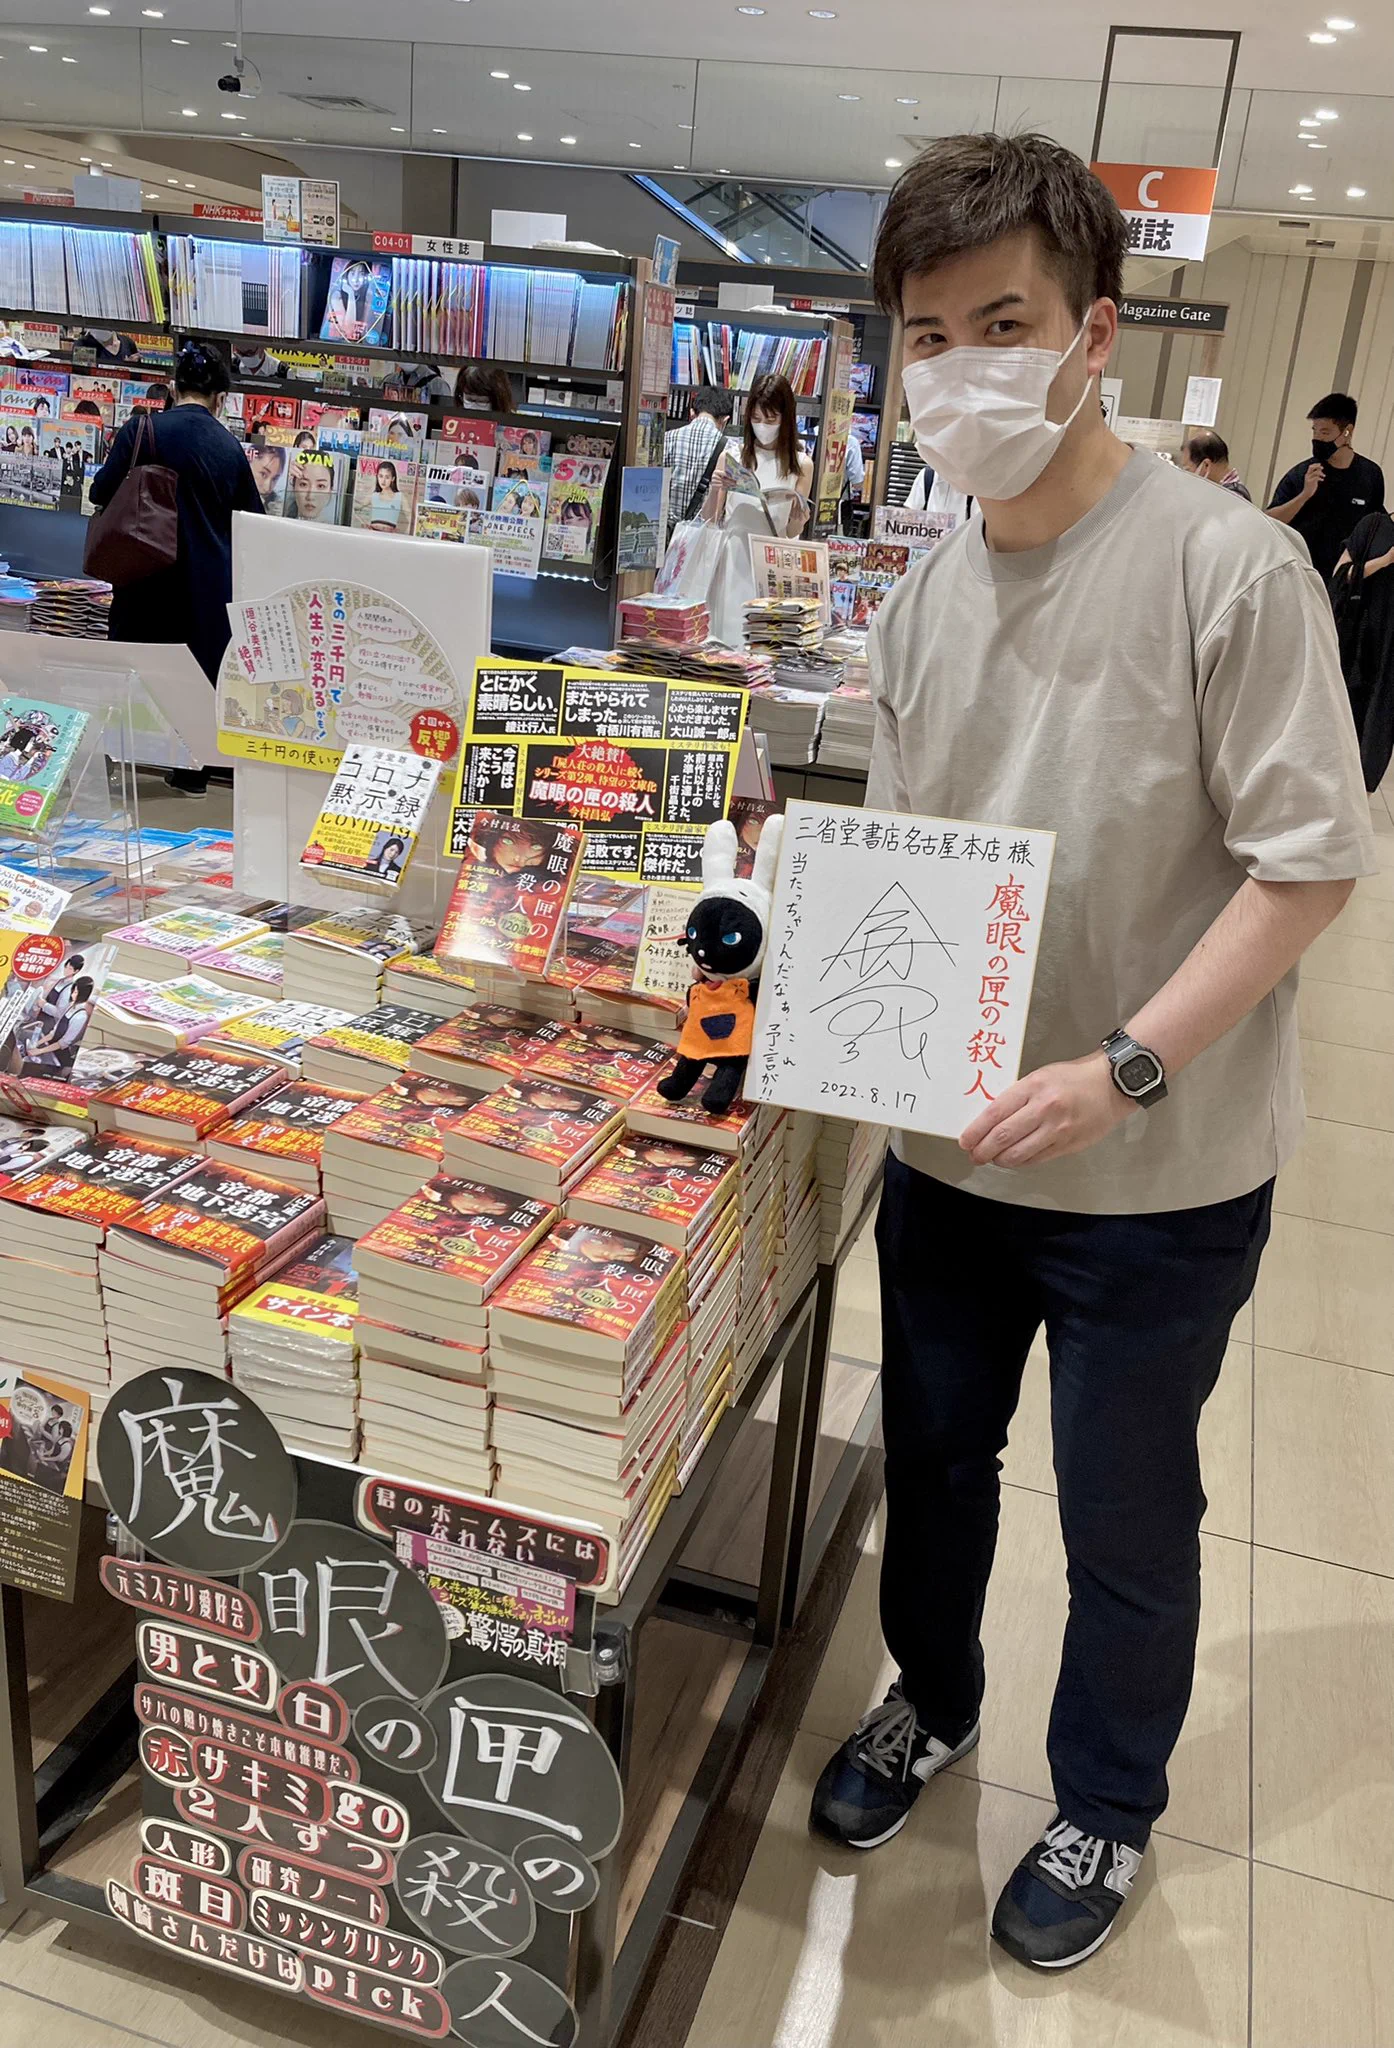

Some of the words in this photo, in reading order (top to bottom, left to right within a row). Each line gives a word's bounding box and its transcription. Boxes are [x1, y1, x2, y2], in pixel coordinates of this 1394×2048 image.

[1138, 171, 1164, 208] C
[374, 235, 410, 249] C04-01
[427, 239, 470, 255] 女性誌
[1180, 307, 1211, 321] Gate
[296, 451, 334, 467] CYAN
[885, 519, 943, 540] Number
[329, 591, 345, 703] その三千円で
[477, 692, 558, 713] 素晴らしい。
[480, 675, 538, 694] とにかく
[565, 690, 650, 708] またやられて
[418, 714, 452, 729] 全国から
[505, 720, 556, 734] 綾辻行人氏
[565, 707, 623, 724] しまった。
[668, 703, 739, 716] 心から楽しませて
[668, 713, 732, 727] いただきました。
[417, 729, 452, 752] 反響
[595, 723, 661, 738] 有栖川有栖氏
[670, 725, 737, 741] 大山誠一郎氏
[340, 760, 430, 790] コロナ
[491, 747, 503, 775] こう
[692, 752, 707, 807] 前作以上の
[529, 779, 655, 815] 魔眼の匣の殺人
[534, 767, 658, 793] シリーズ第2弾、待望の文庫化
[680, 752, 695, 822] 水準に達した。
[713, 753, 725, 809] 高いハードルを
[328, 782, 421, 819] 黙示録
[568, 806, 612, 822] 今村昌弘
[479, 816, 522, 833] 今村昌弘
[795, 815, 1002, 863] 三省堂書店名古屋本店
[1007, 838, 1036, 868] 様
[583, 843, 638, 860] 完敗です。
[643, 858, 691, 875] 傑作だ。
[456, 879, 488, 894] 第2弾
[508, 872, 538, 915] 殺人
[529, 831, 575, 939] 魔眼の匣の
[963, 872, 1030, 1102] 魔眼の匣の殺人
[146, 1062, 251, 1094] 地下迷宮
[186, 1058, 244, 1077] 帝都
[299, 1095, 358, 1119] 帝都
[820, 1081, 917, 1113] 2022.8.17
[58, 1151, 172, 1188] 地下迷宮
[104, 1147, 168, 1169] 帝都
[171, 1182, 287, 1230] 地下迷宮
[215, 1179, 281, 1206] 帝都
[456, 1215, 496, 1242] 殺人
[591, 1263, 628, 1293] 殺人
[117, 1376, 280, 1544] 魔
[376, 1486, 596, 1561] 君のホームズには
[430, 1520, 535, 1562] なれない
[116, 1568, 247, 1630] 元ミステリ愛好会
[257, 1555, 420, 1701] 眼
[149, 1630, 261, 1699] 男と女
[293, 1692, 334, 1736] 白
[141, 1695, 350, 1778] サバの照り焼きこそ本格推理だ。
[364, 1718, 422, 1760] の
[147, 1736, 190, 1778] 赤
[442, 1696, 591, 1842] 匣
[201, 1745, 309, 1815] サキミ
[187, 1787, 384, 1870] 2人ずつ
[335, 1791, 402, 1836] go
[156, 1831, 217, 1868] 人形
[144, 1864, 235, 1925] 斑目
[251, 1856, 383, 1923] 研究ノート
[522, 1857, 585, 1897] の
[404, 1846, 518, 1947] 殺
[256, 1897, 429, 1978] ミッシングリンク
[313, 1964, 425, 2022] pick
[458, 1970, 561, 2048] 人
